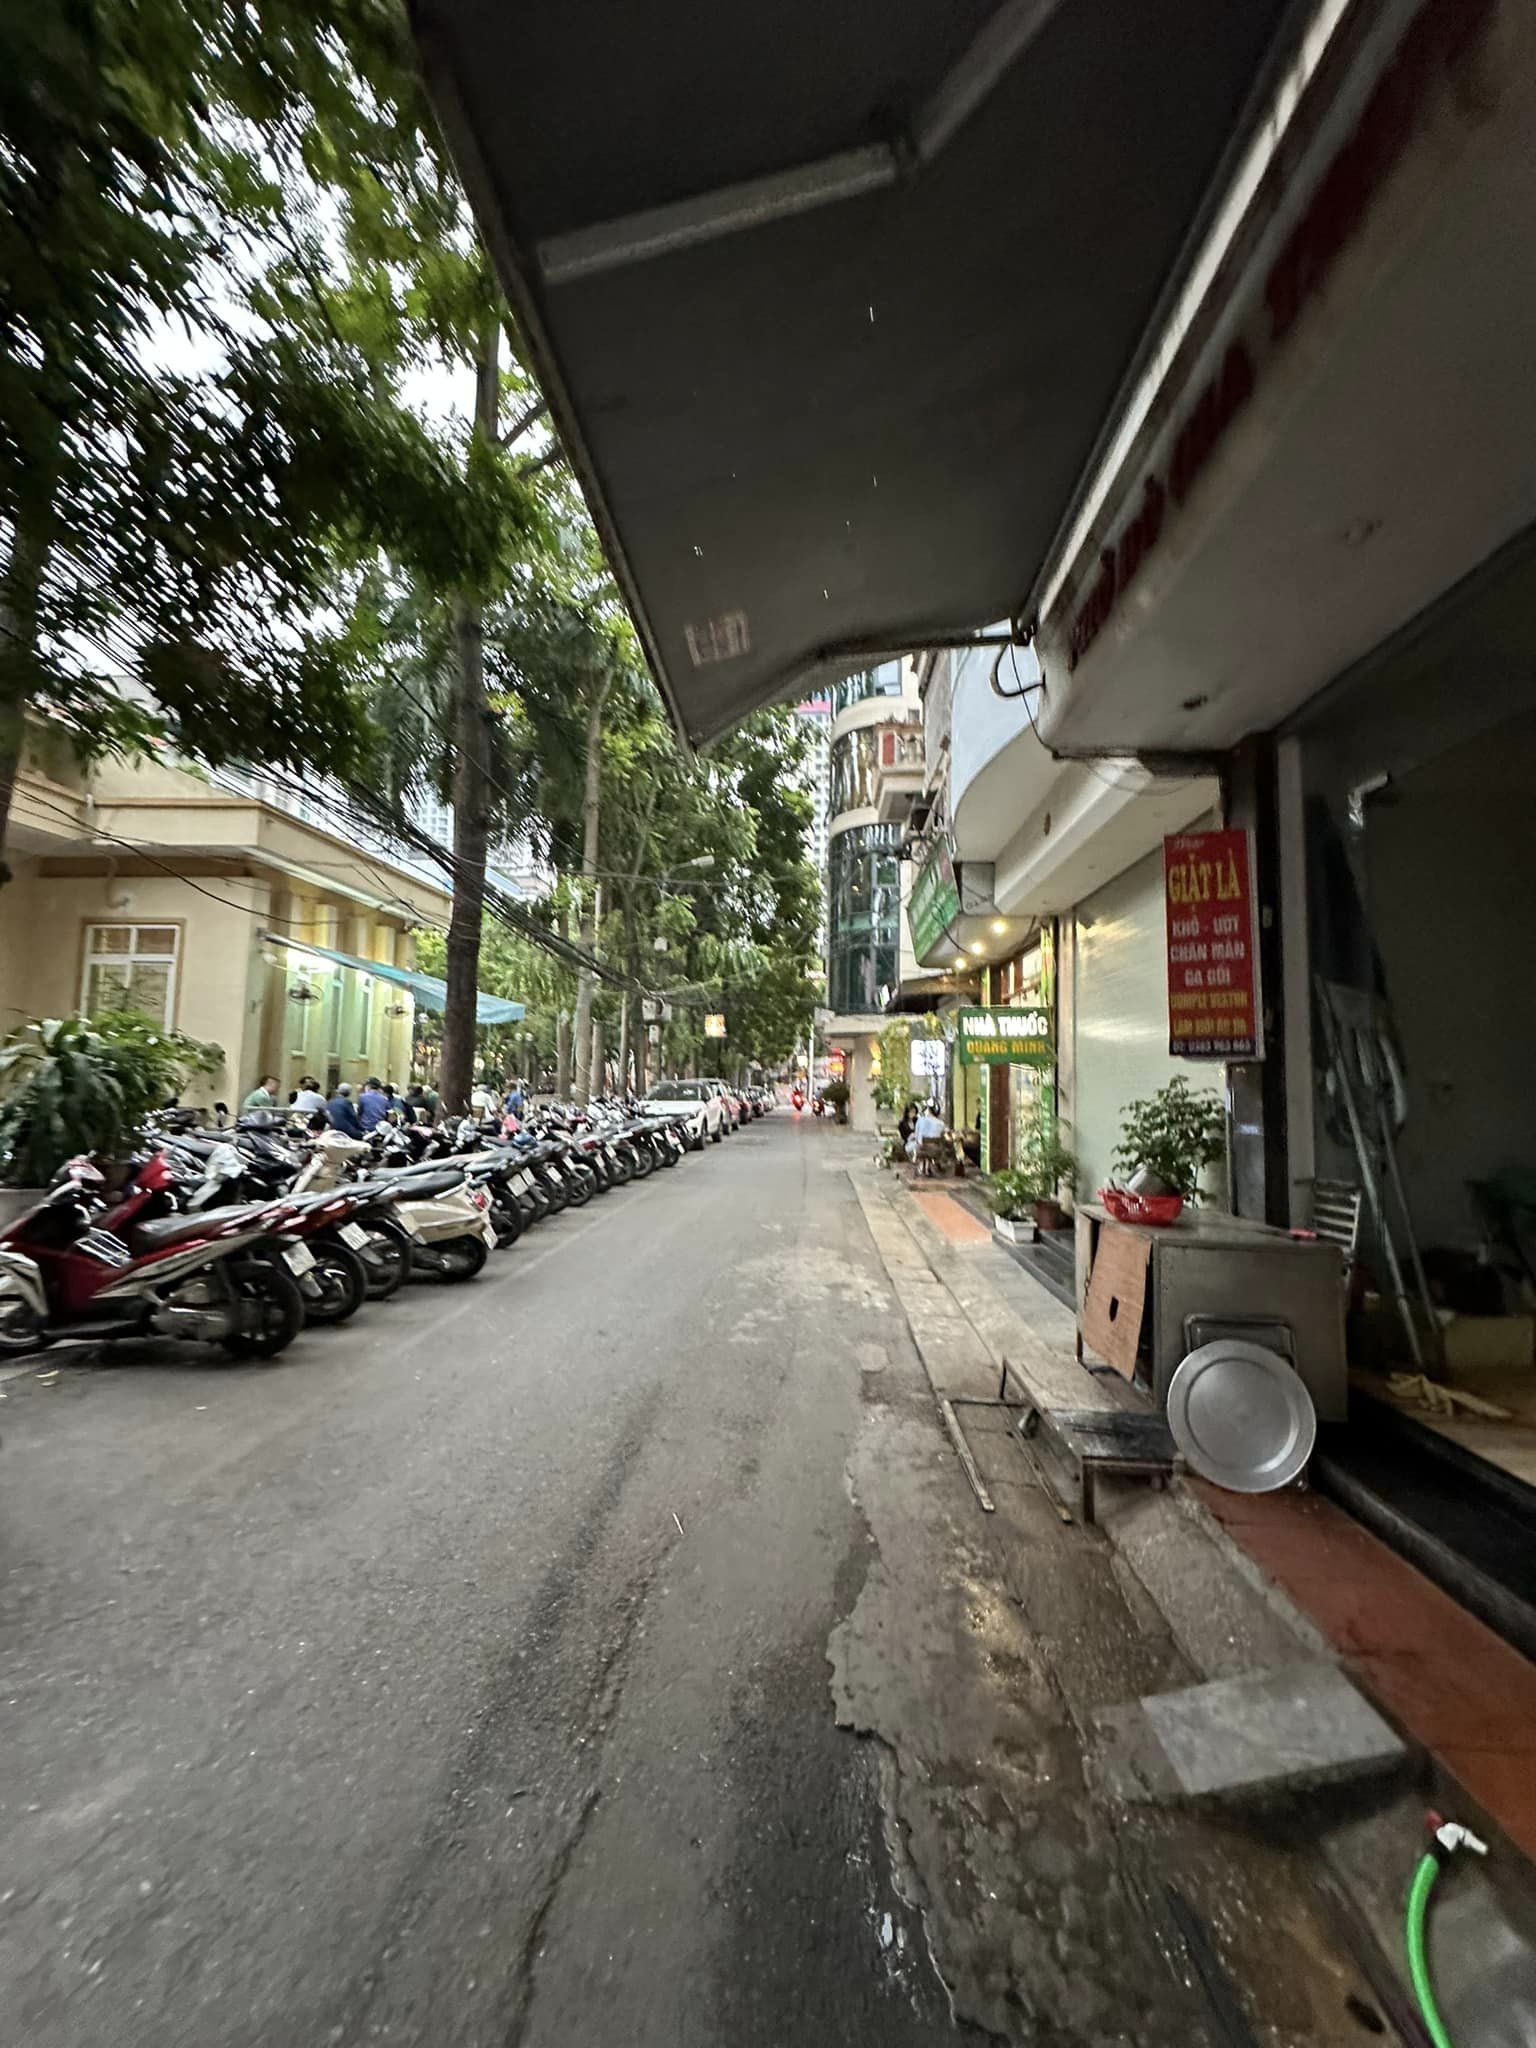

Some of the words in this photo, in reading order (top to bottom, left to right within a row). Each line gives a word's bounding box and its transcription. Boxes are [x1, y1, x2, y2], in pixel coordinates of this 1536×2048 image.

[1216, 848, 1241, 899] LÀ
[1172, 913, 1200, 937] KHÔ
[963, 1012, 996, 1037] NHÀ
[998, 1010, 1049, 1037] THUỐC
[966, 1040, 1009, 1055] QUANG
[1012, 1039, 1047, 1055] MINH
